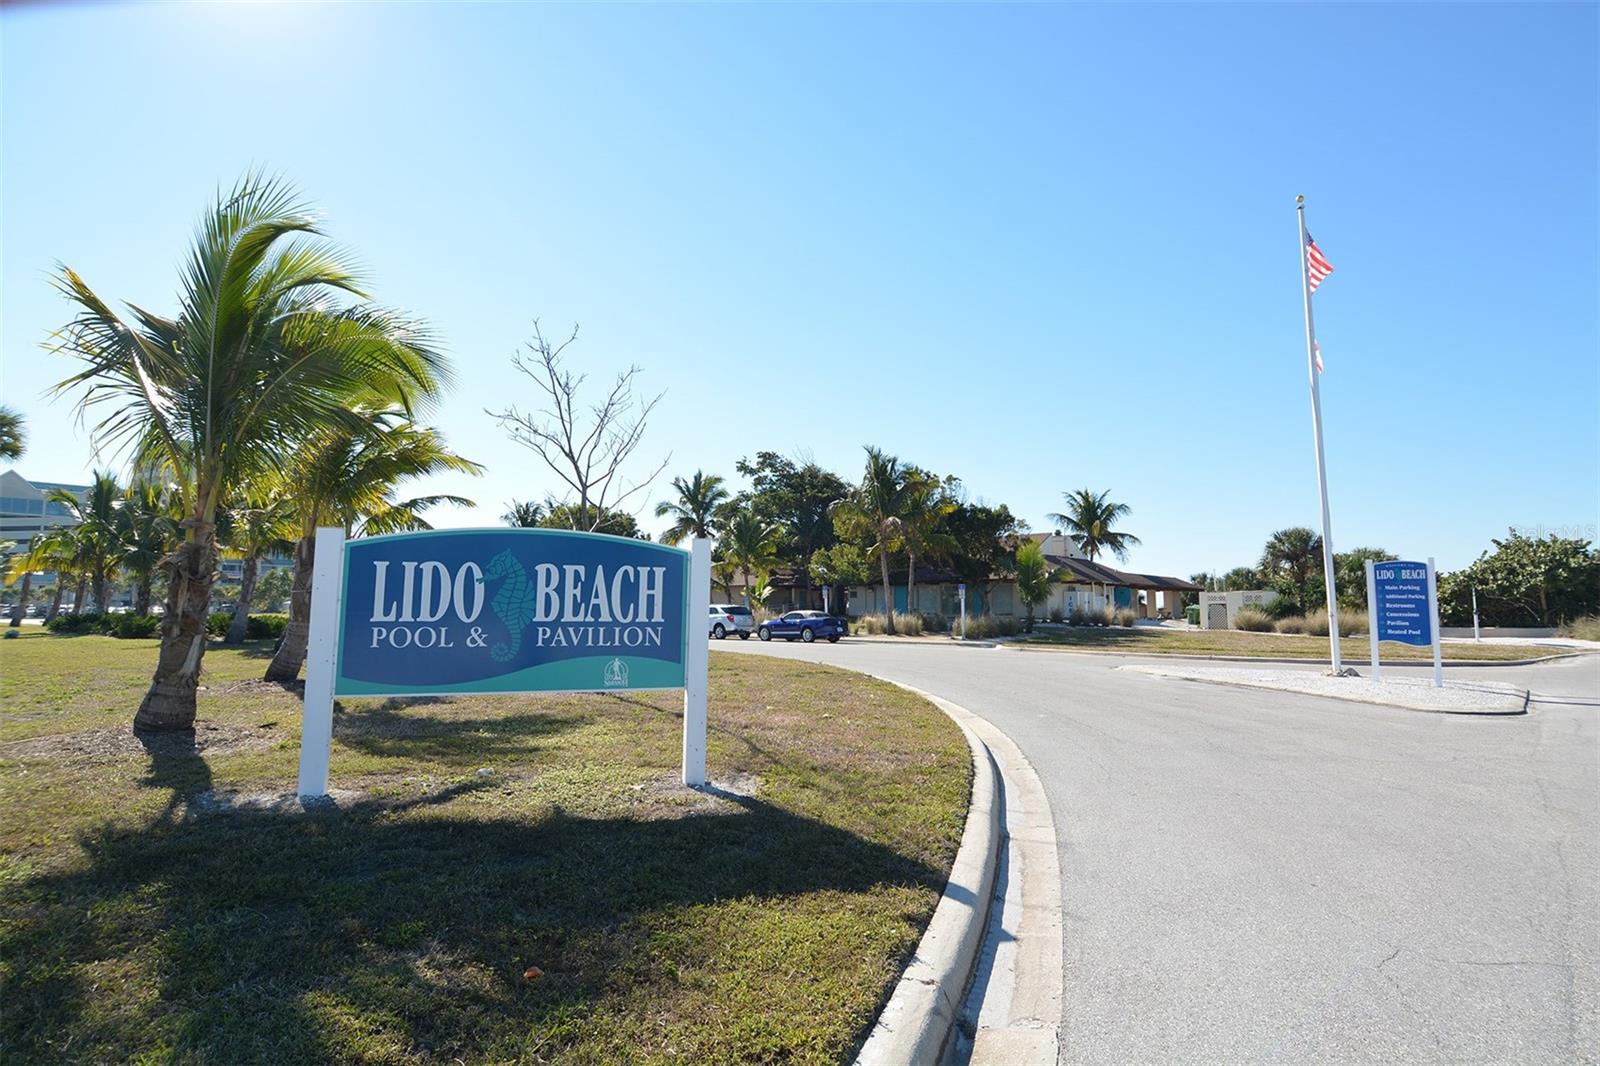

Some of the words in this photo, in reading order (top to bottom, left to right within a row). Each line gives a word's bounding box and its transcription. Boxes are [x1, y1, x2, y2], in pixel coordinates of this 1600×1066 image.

[1376, 570, 1395, 579] LIDO
[1401, 570, 1426, 579] BEACH
[370, 560, 485, 622] LIDO
[533, 563, 666, 623] BEACH
[370, 627, 453, 648] POOL
[466, 626, 487, 648] &
[536, 626, 662, 648] PAVILION
